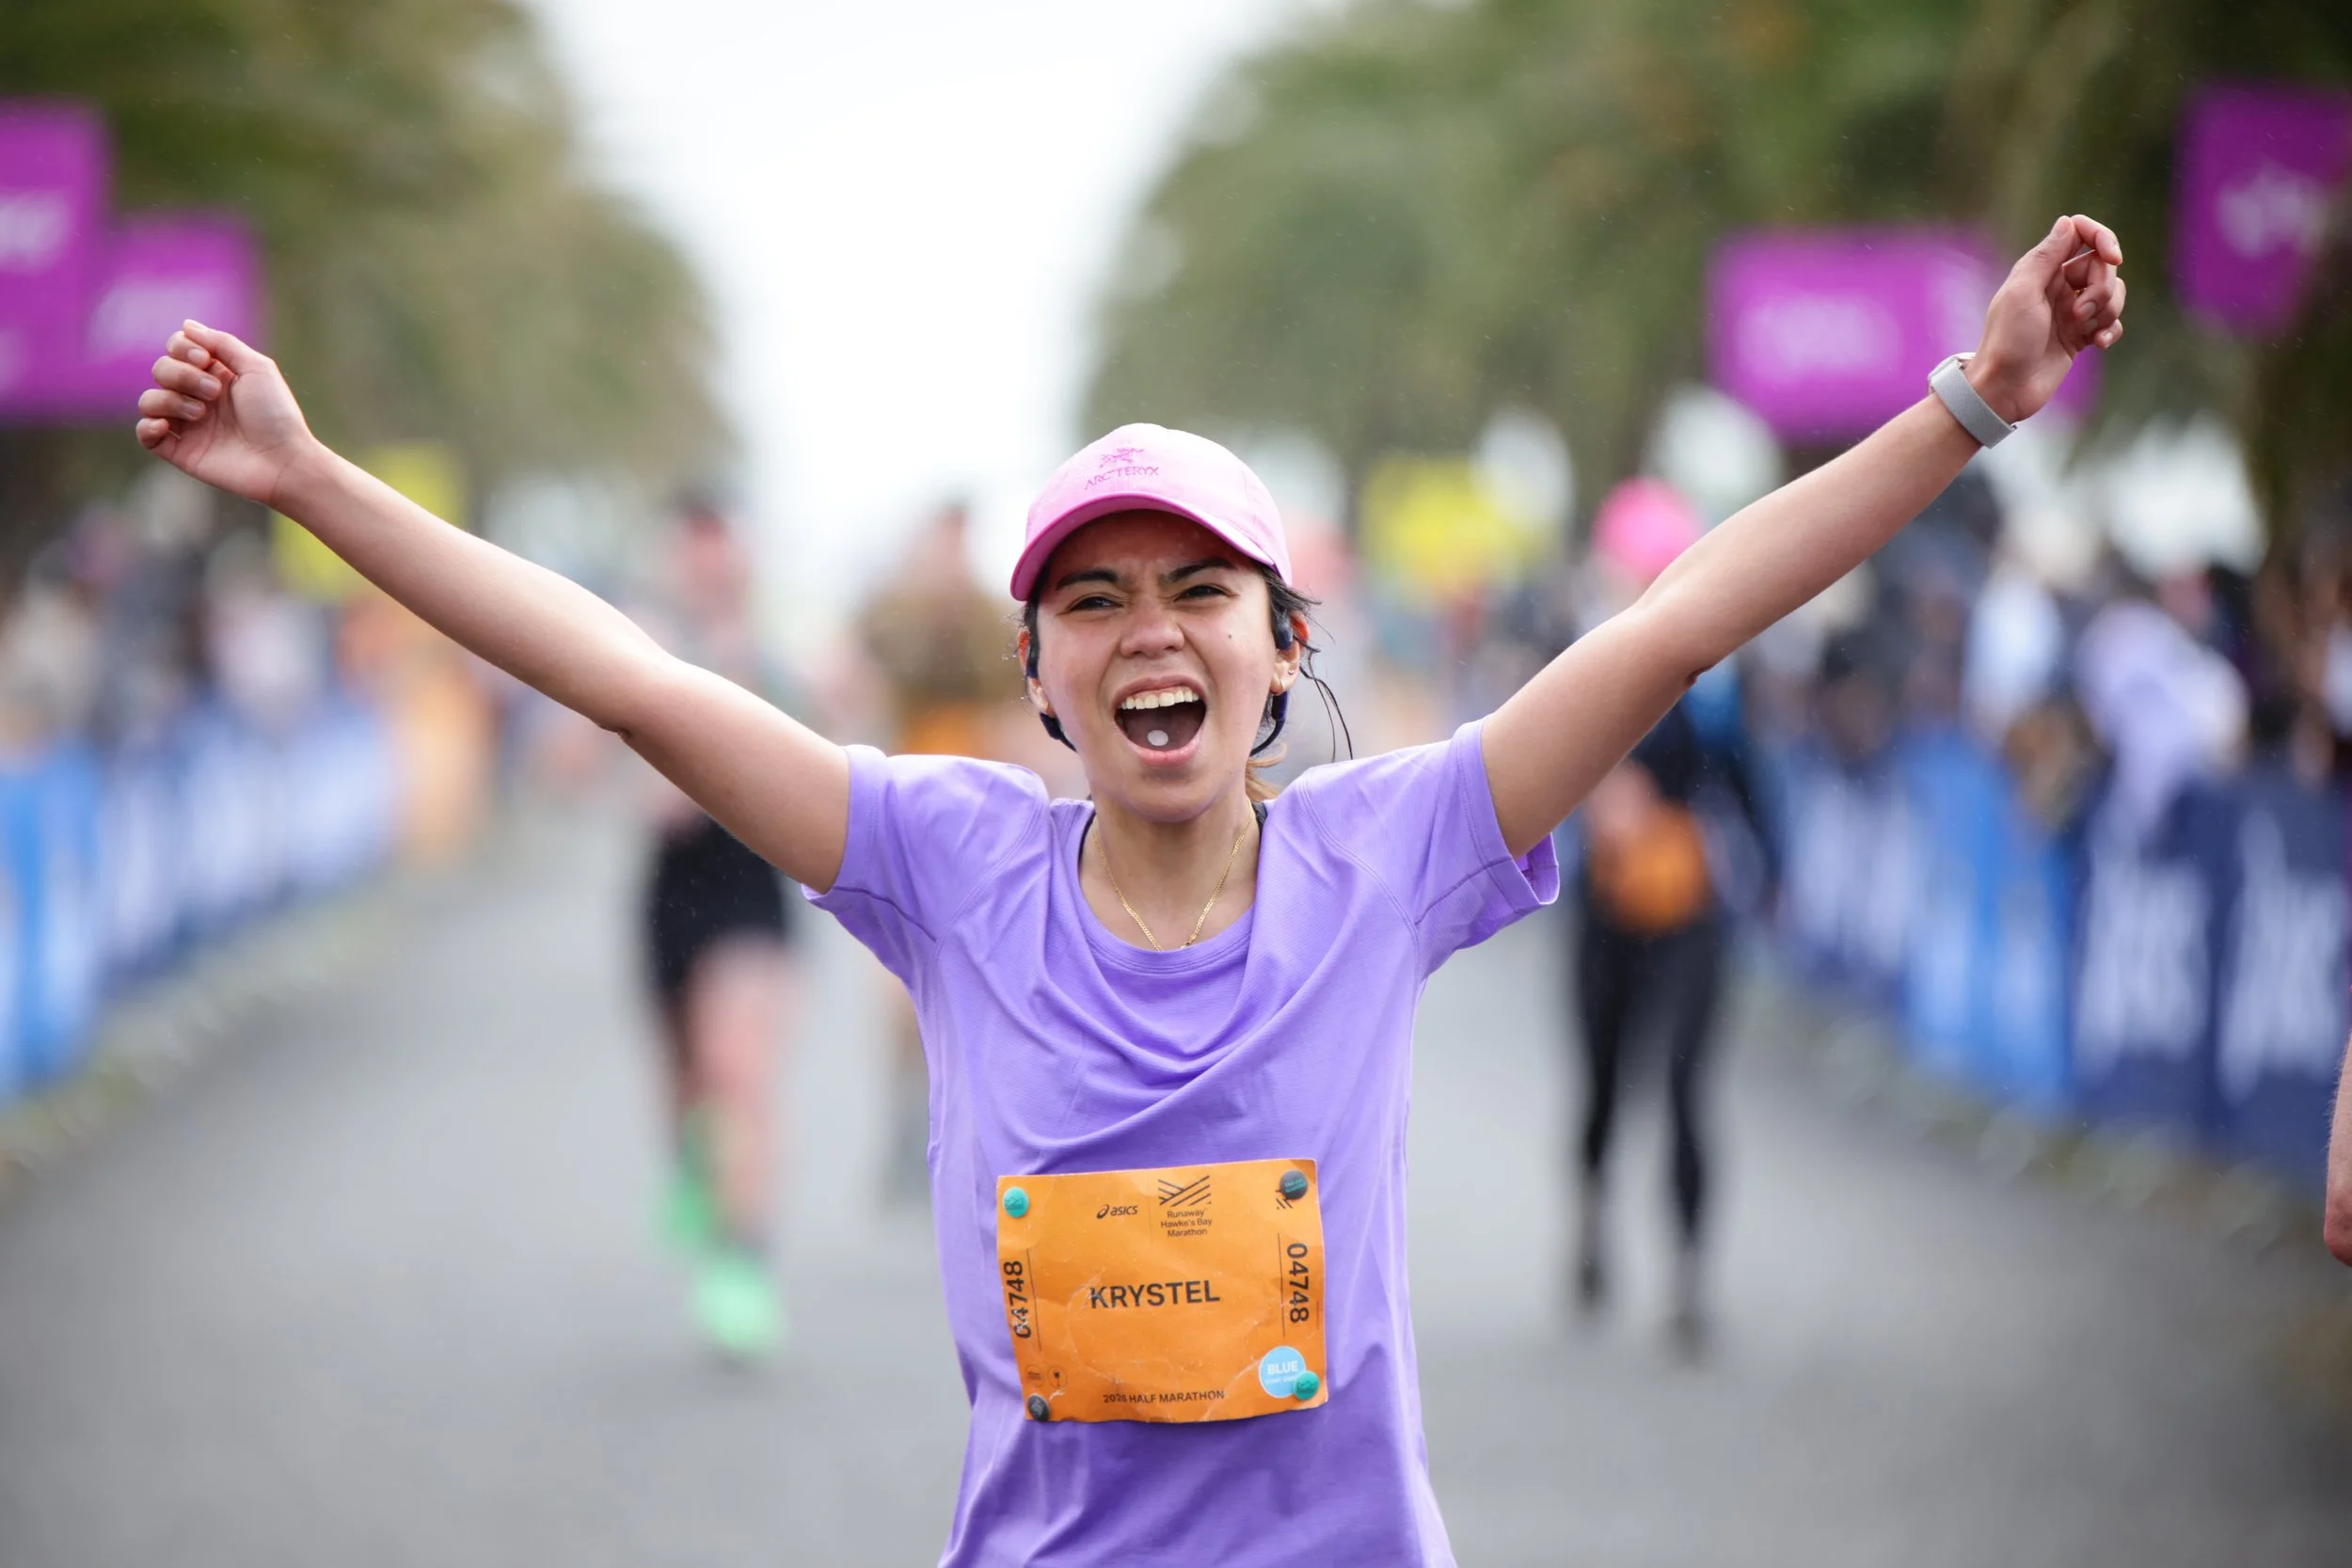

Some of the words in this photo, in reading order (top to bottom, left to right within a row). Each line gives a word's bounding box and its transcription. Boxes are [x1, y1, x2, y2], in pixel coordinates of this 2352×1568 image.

[1167, 1210, 1205, 1218] Runaway
[1160, 1219, 1196, 1228] Hawke's
[1197, 1218, 1213, 1227] Bay
[1167, 1228, 1208, 1238] Marathon
[1286, 1243, 1310, 1324] 04748
[1090, 1279, 1221, 1309] KRYSTEL
[1267, 1360, 1299, 1375] BLUE
[1129, 1393, 1157, 1404] HALF
[1158, 1390, 1225, 1402] MARATHON
